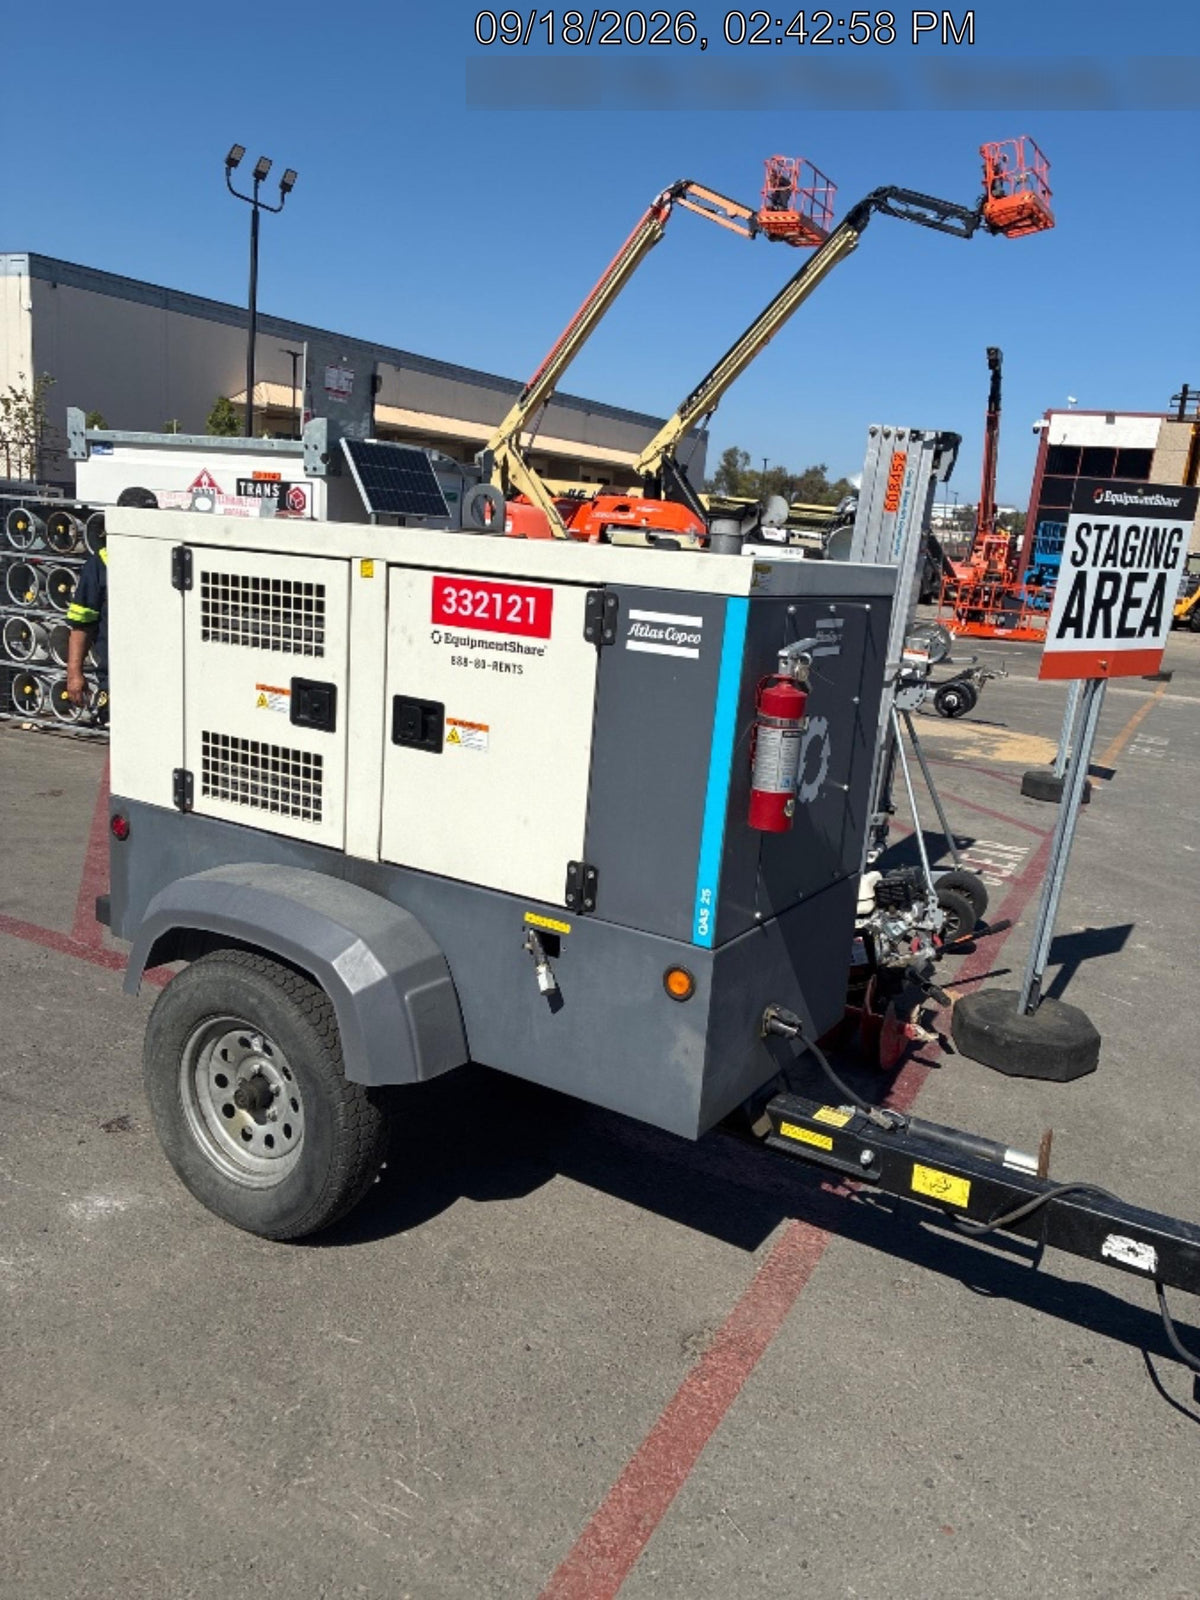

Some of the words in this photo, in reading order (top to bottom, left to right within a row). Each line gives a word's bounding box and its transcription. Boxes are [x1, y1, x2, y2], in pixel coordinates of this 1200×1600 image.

[239, 482, 280, 497] TRANS
[1070, 522, 1184, 570] STAGING
[441, 586, 536, 625] 332121
[1055, 570, 1168, 639] AREA
[443, 632, 545, 657] EquipmentShare
[627, 623, 664, 639] Atlas
[665, 627, 702, 645] Copco
